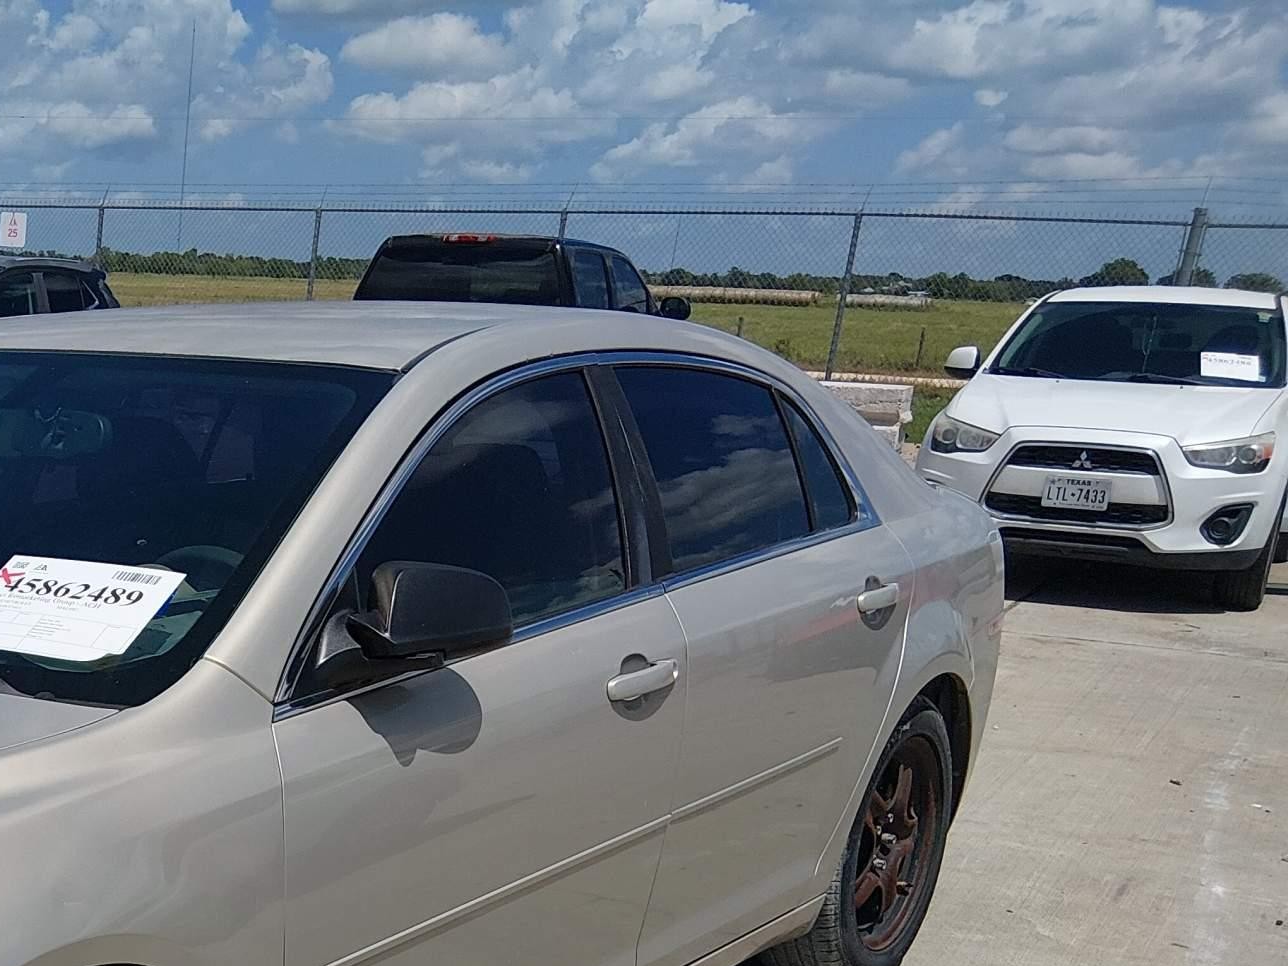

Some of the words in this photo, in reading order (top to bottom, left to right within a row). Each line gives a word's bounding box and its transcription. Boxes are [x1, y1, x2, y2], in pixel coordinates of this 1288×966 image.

[8, 229, 18, 238] 25
[1066, 479, 1092, 487] TEXAS
[4, 577, 144, 607] 45862489
